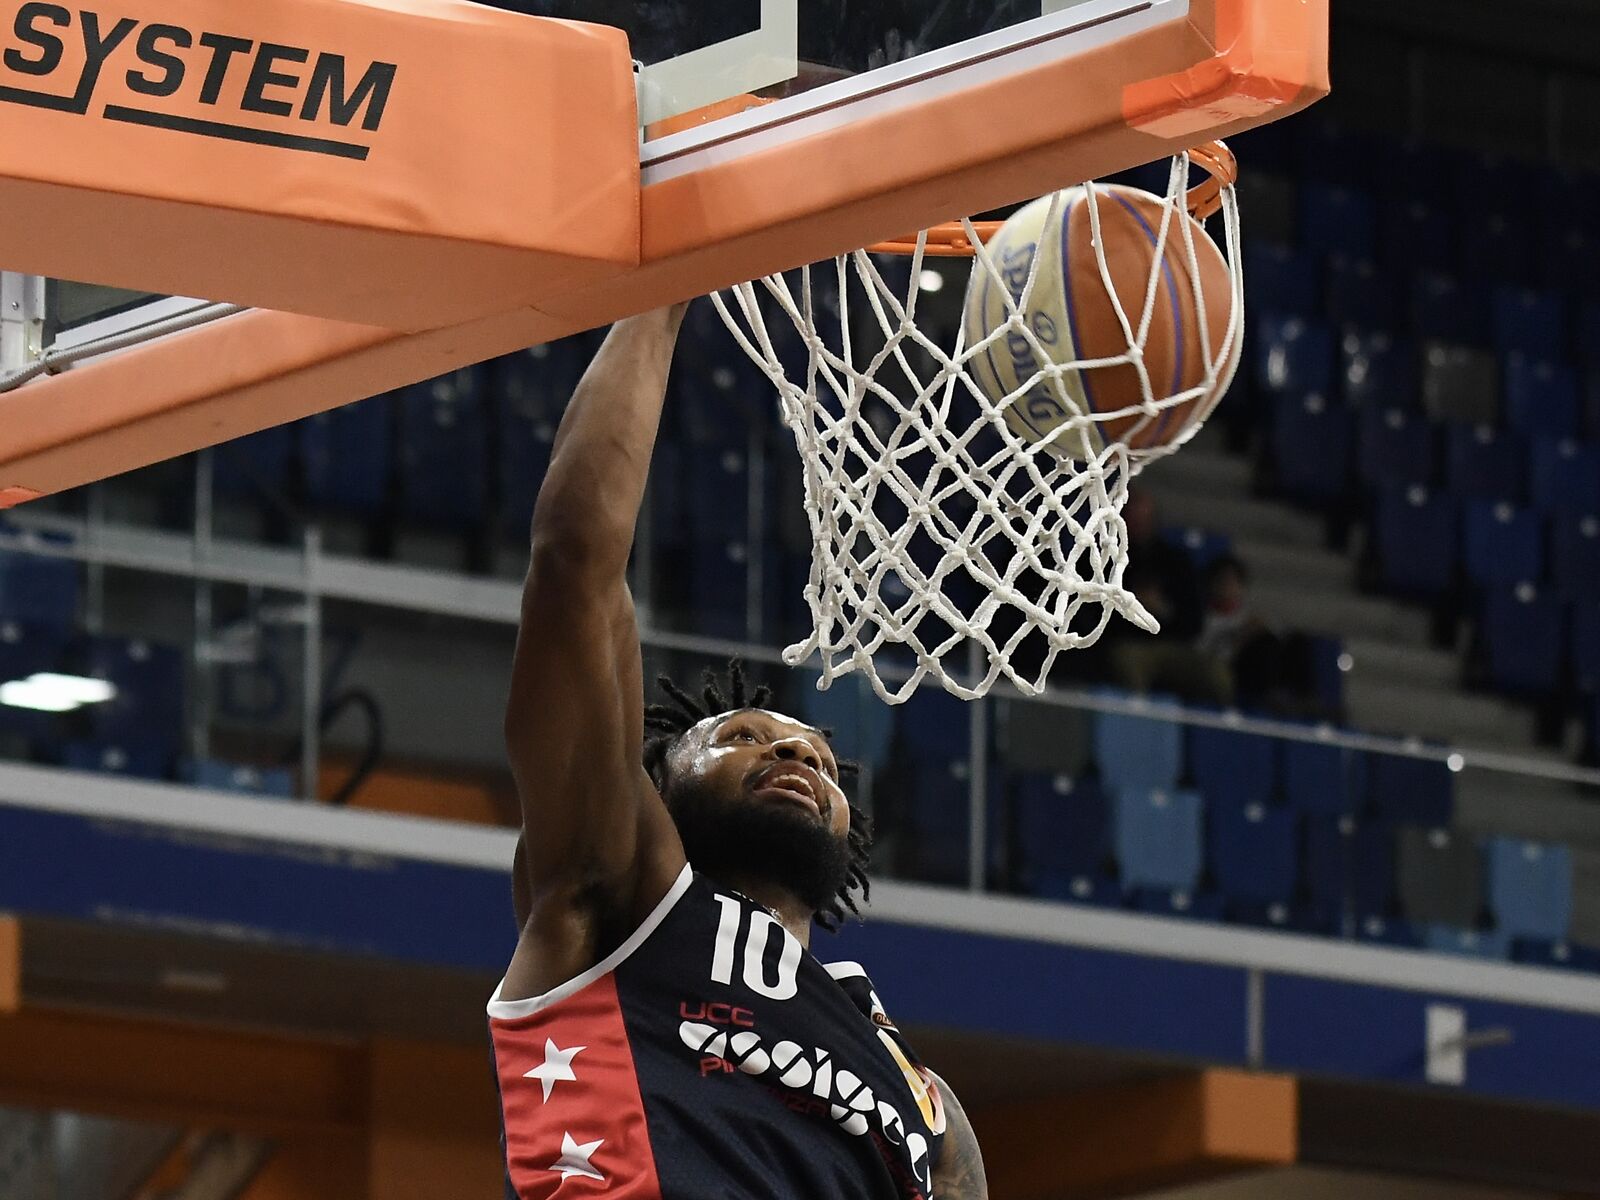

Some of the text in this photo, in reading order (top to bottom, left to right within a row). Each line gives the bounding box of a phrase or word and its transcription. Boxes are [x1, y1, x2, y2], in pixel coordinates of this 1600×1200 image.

[3, 2, 397, 132] SYSTEM
[711, 893, 802, 1000] 10
[679, 1002, 754, 1027] UCC
